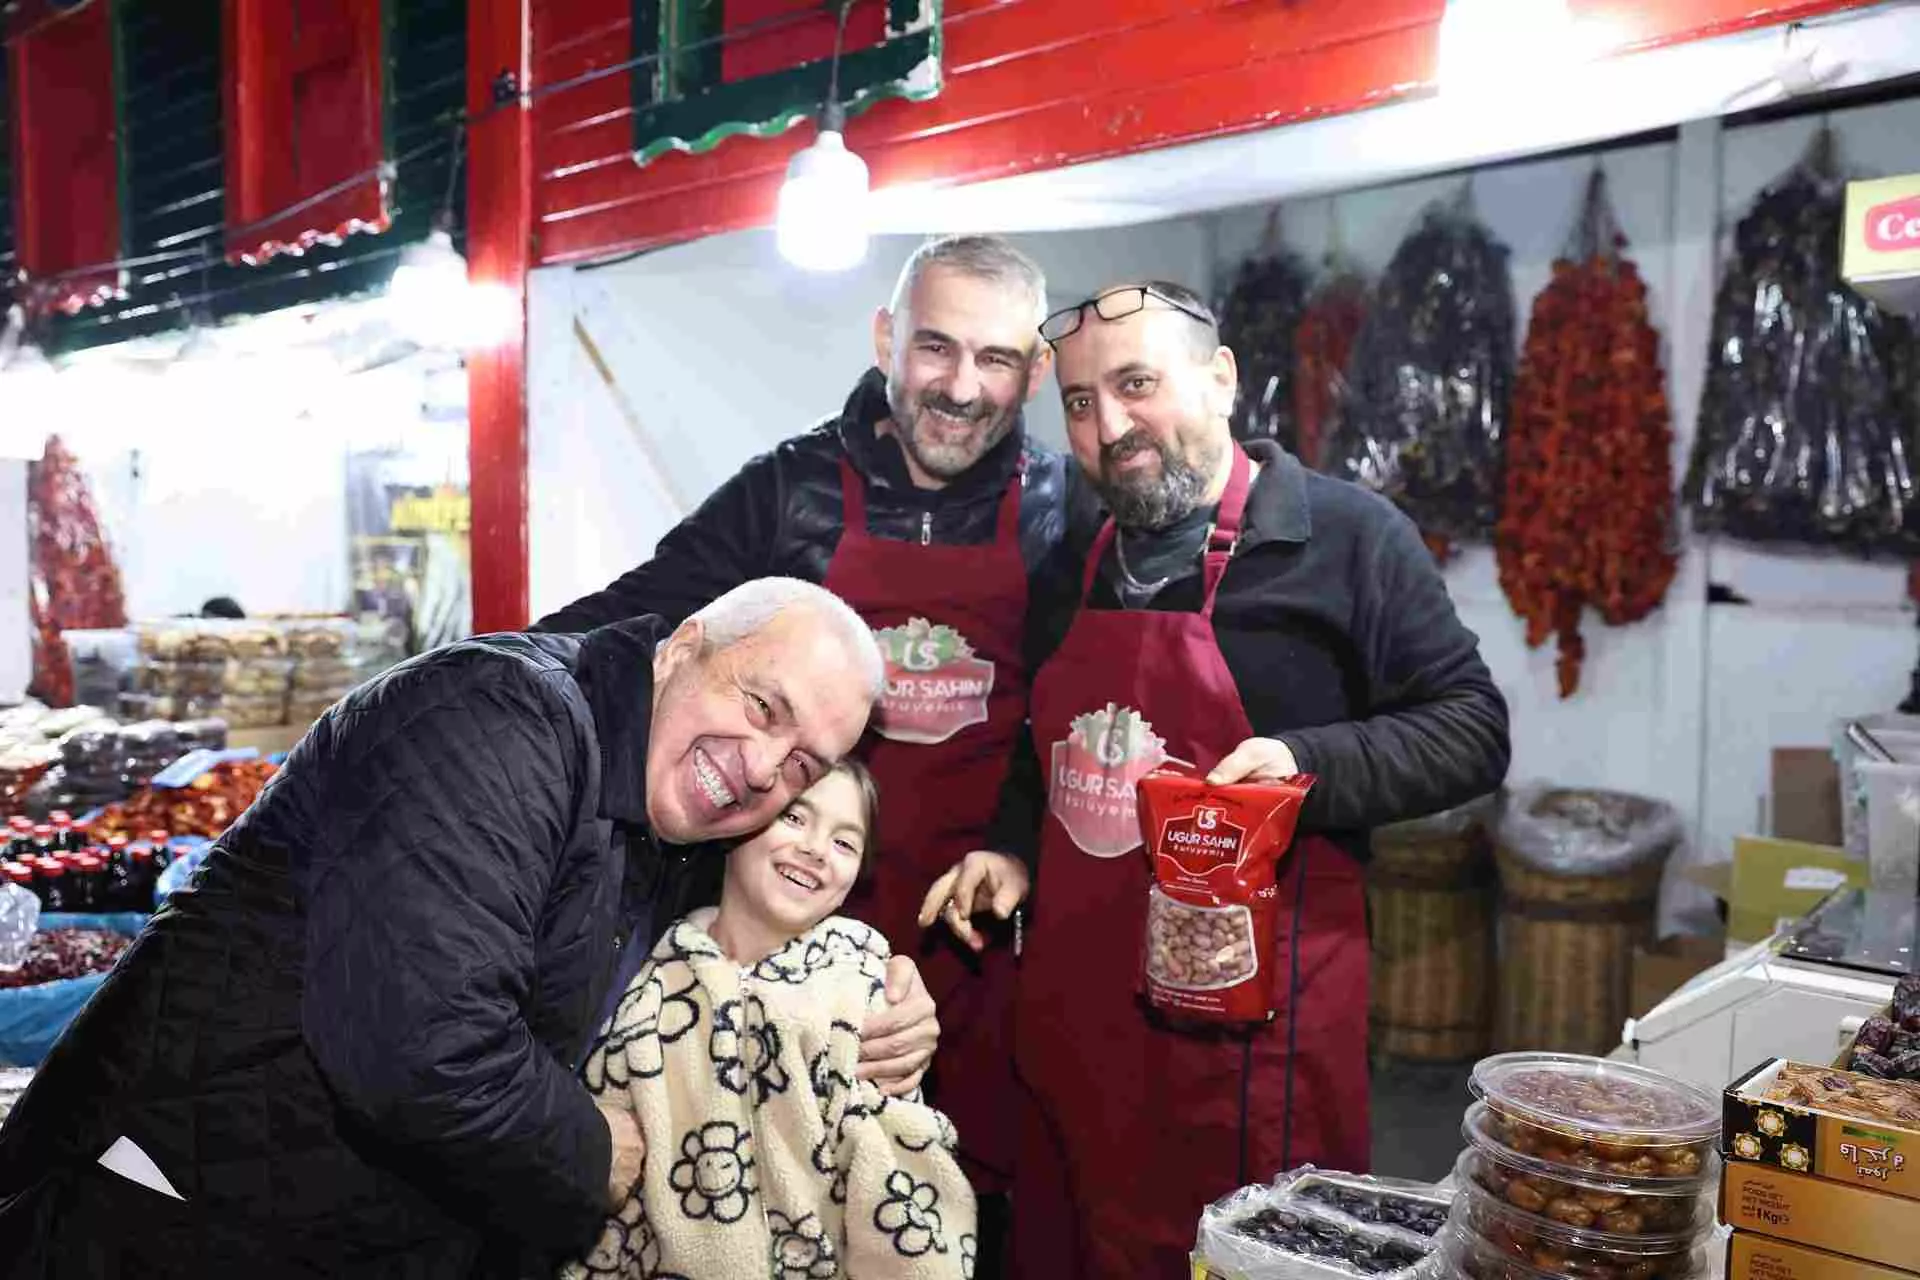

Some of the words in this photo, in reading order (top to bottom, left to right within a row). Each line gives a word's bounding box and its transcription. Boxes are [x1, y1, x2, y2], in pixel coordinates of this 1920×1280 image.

[919, 679, 983, 698] SAHIN
[1167, 830, 1201, 845] UGUR
[1201, 834, 1238, 850] SAHIN
